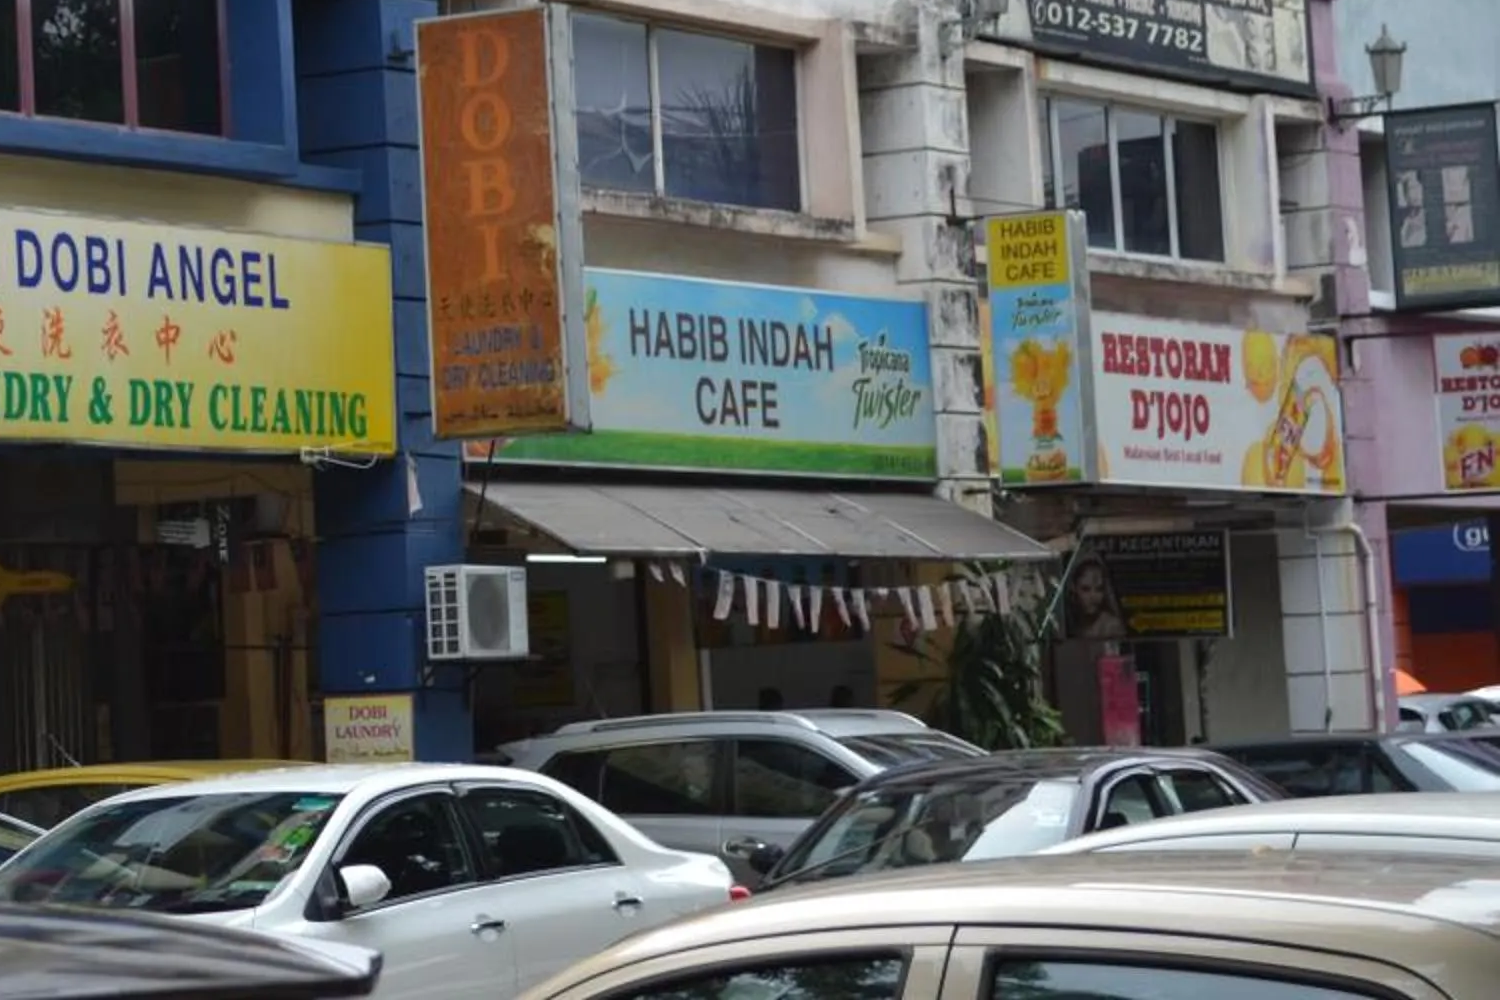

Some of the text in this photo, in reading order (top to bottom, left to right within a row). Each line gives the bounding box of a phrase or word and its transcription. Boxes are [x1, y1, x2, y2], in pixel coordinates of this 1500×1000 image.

[1047, 1, 1139, 39] 012-537
[1145, 21, 1204, 52] 7782
[459, 29, 516, 281] DOBI
[1000, 218, 1056, 239] HABIB
[1000, 241, 1058, 261] INDAH
[15, 229, 127, 297] DOBI
[148, 244, 290, 309] ANGEL
[1005, 261, 1056, 282] CAFE
[629, 308, 834, 372] HABIB INDAH
[1102, 332, 1231, 384] RESTORAN
[87, 376, 114, 426] &
[128, 378, 196, 430] DRY
[208, 384, 369, 438] CLEANING
[695, 376, 780, 428] CAFE
[852, 378, 922, 430] Twister
[1130, 389, 1211, 441] D'JOJO
[334, 722, 401, 739] LAUNDRY
[349, 705, 388, 721] DOBI
